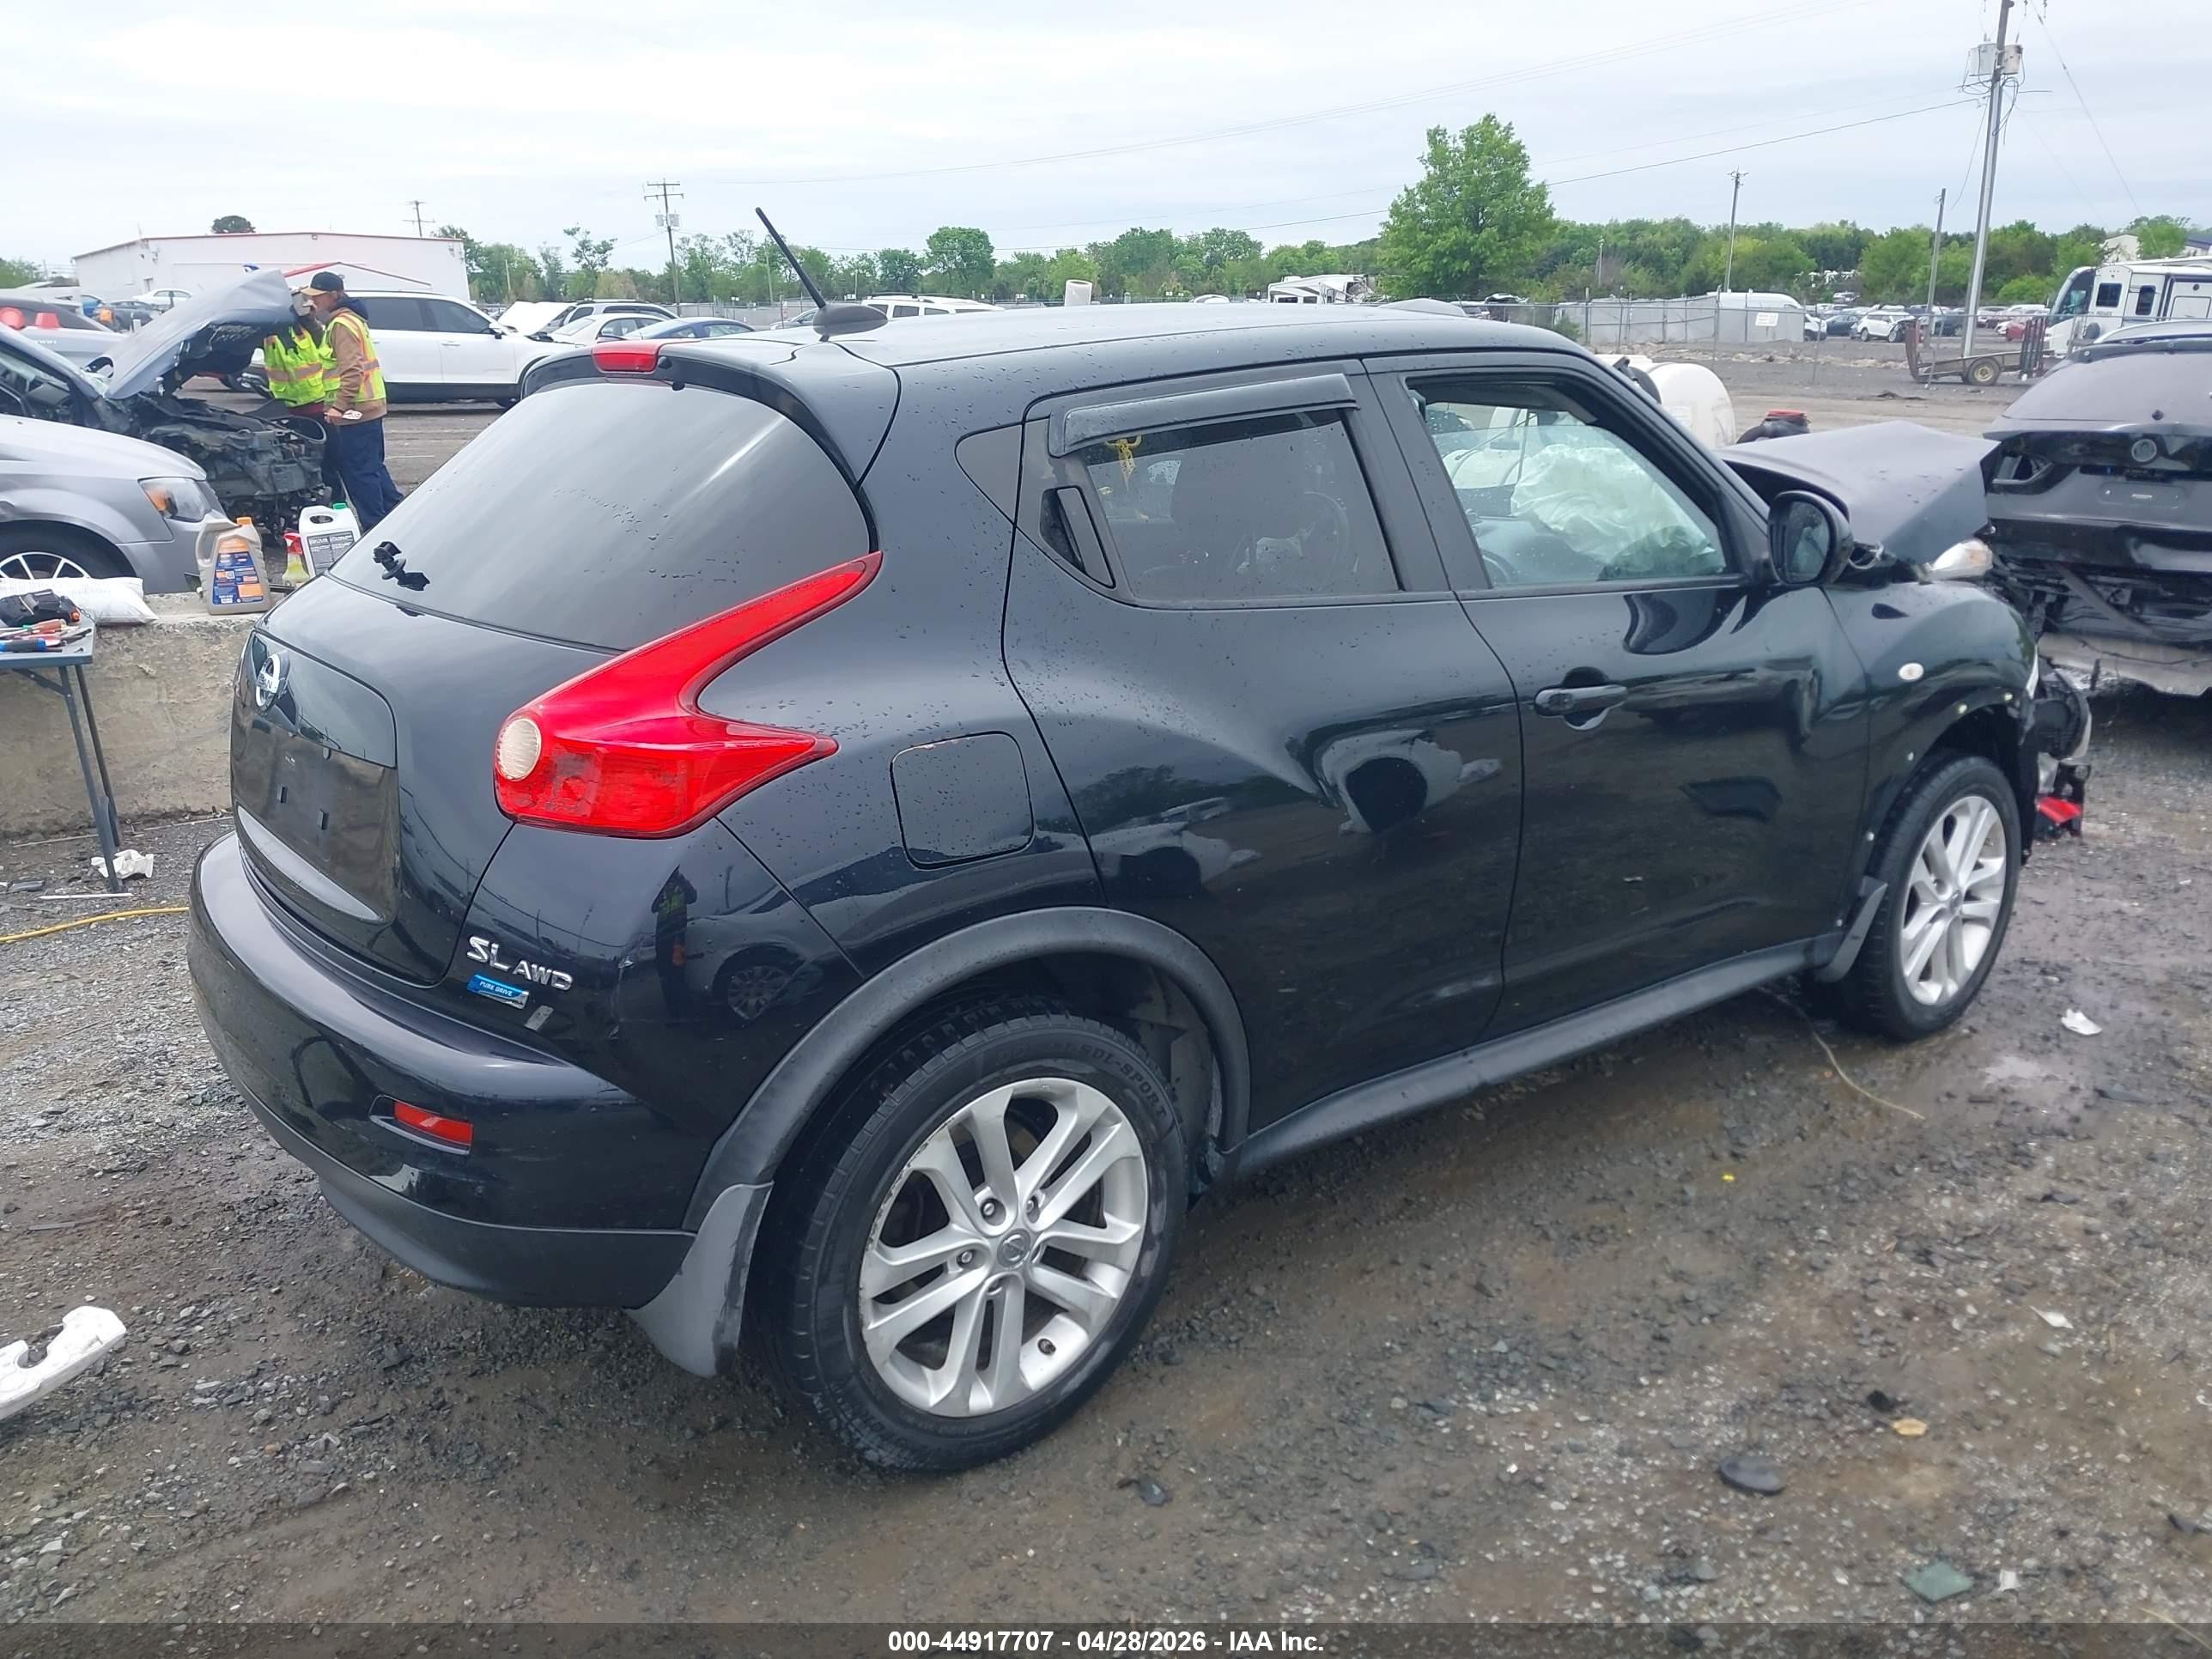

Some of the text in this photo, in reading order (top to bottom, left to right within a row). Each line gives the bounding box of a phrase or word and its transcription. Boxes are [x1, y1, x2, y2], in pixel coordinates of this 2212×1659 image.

[466, 936, 574, 991] SL AWD
[479, 981, 514, 996] PURE DRIVE
